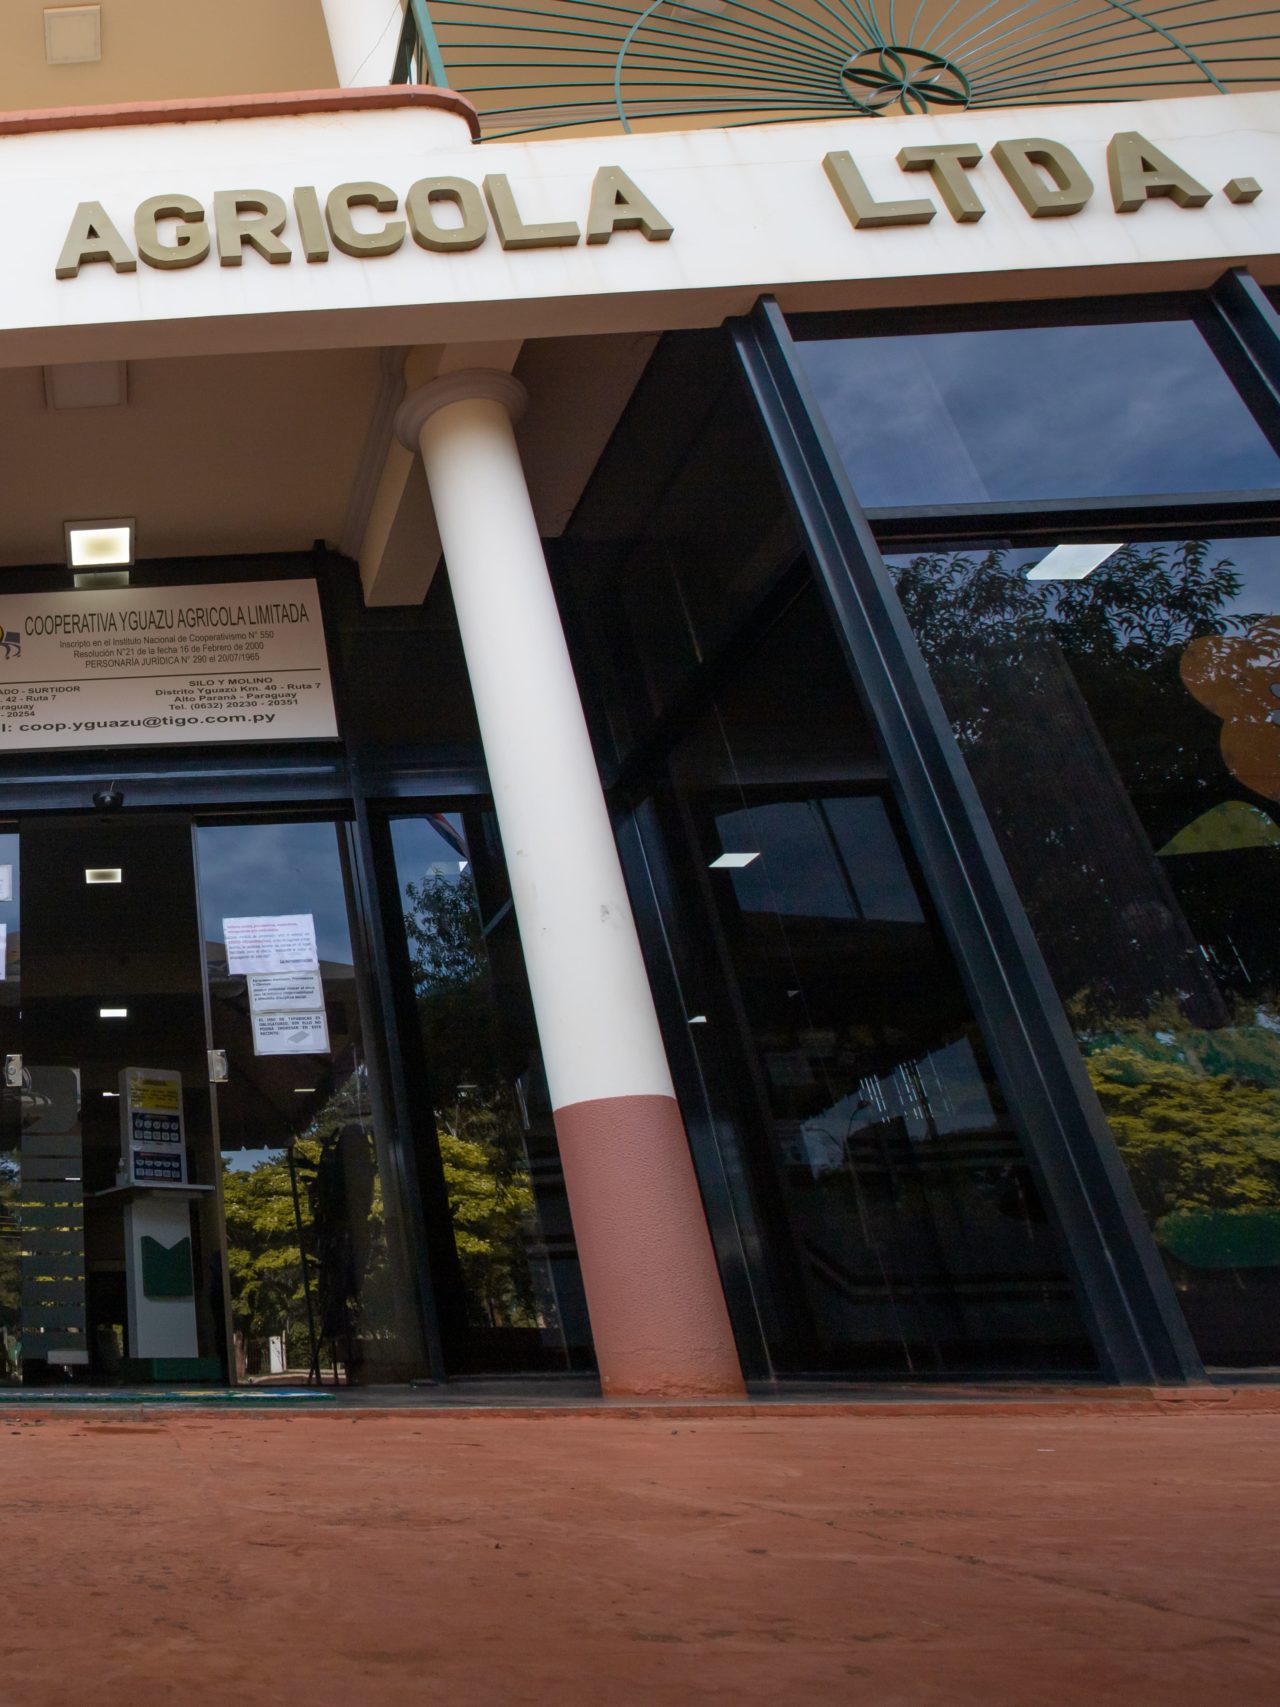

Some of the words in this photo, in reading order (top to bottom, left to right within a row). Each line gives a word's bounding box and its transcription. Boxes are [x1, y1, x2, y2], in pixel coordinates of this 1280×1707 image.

[55, 165, 675, 280] AGRICOLA
[821, 130, 1263, 230] LTDA.
[24, 612, 118, 636] COOPERATIVA
[119, 609, 174, 631] YGUAZU
[177, 605, 246, 629] AGRICOLA
[247, 603, 310, 625] LIMITADA
[59, 639, 91, 649] Inscripto
[104, 639, 111, 647] el
[113, 637, 142, 646] Instituto
[143, 635, 176, 644] Nacional
[178, 635, 188, 643] de
[189, 632, 247, 642] Cooperativismo
[260, 630, 274, 639] 550
[73, 649, 115, 658] Resolución
[136, 647, 146, 655] de
[148, 647, 155, 655] la
[157, 645, 178, 654] fecha
[179, 645, 189, 653] 16
[203, 643, 232, 652] Febrero
[234, 643, 244, 651] de
[245, 641, 264, 650] 2000
[193, 654, 207, 664] 290
[209, 654, 216, 662] el
[217, 652, 260, 663] 20/07/1965
[228, 677, 273, 685] MOLINO
[28, 686, 81, 694] SURTIDOR
[155, 688, 194, 696] Distrito
[6, 695, 17, 703] 42
[26, 694, 49, 702] Ruta
[246, 692, 297, 700] Paraguay
[190, 702, 223, 711] (0632)
[7, 710, 36, 718] 20254
[18, 713, 276, 732] coop.yguazu@tigo.com.py
